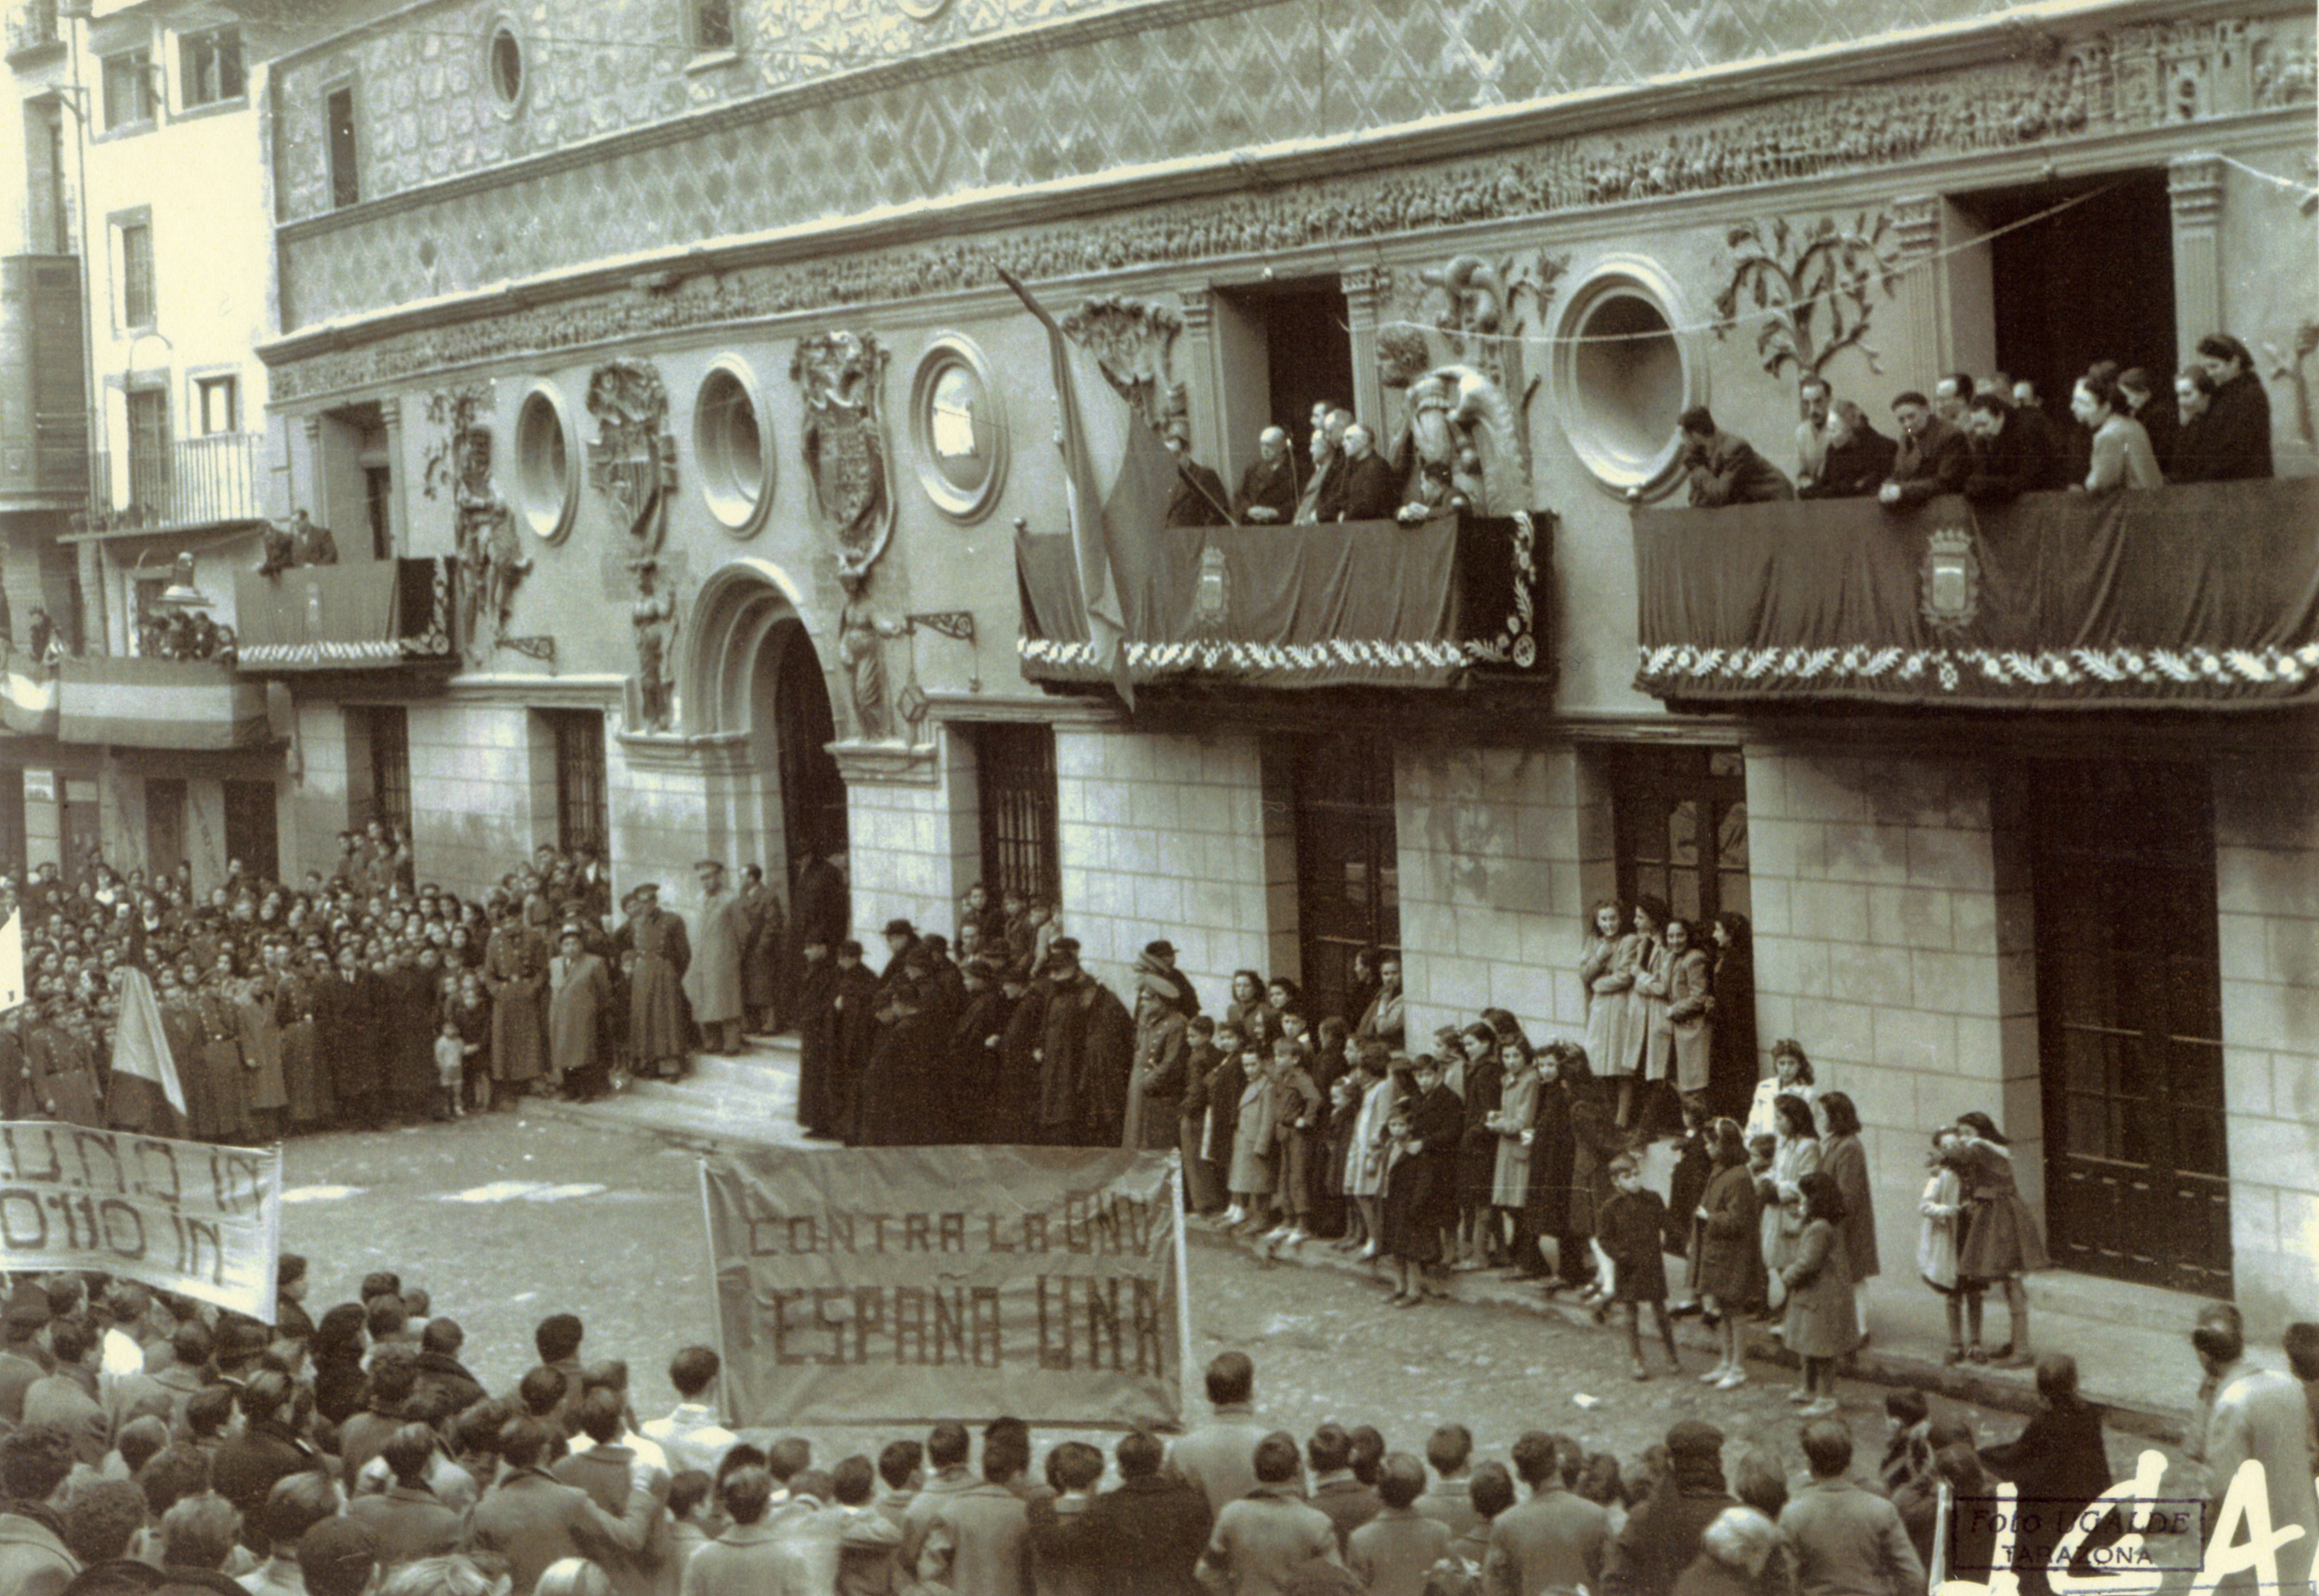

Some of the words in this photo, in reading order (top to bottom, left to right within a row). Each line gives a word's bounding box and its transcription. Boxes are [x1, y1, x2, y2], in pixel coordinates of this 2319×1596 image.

[749, 1212, 965, 1257] CONTRA
[987, 1212, 1048, 1253] LA
[1065, 1190, 1149, 1257] ONU
[773, 1271, 1003, 1369] ESPAÑA
[1037, 1275, 1163, 1379] UNA
